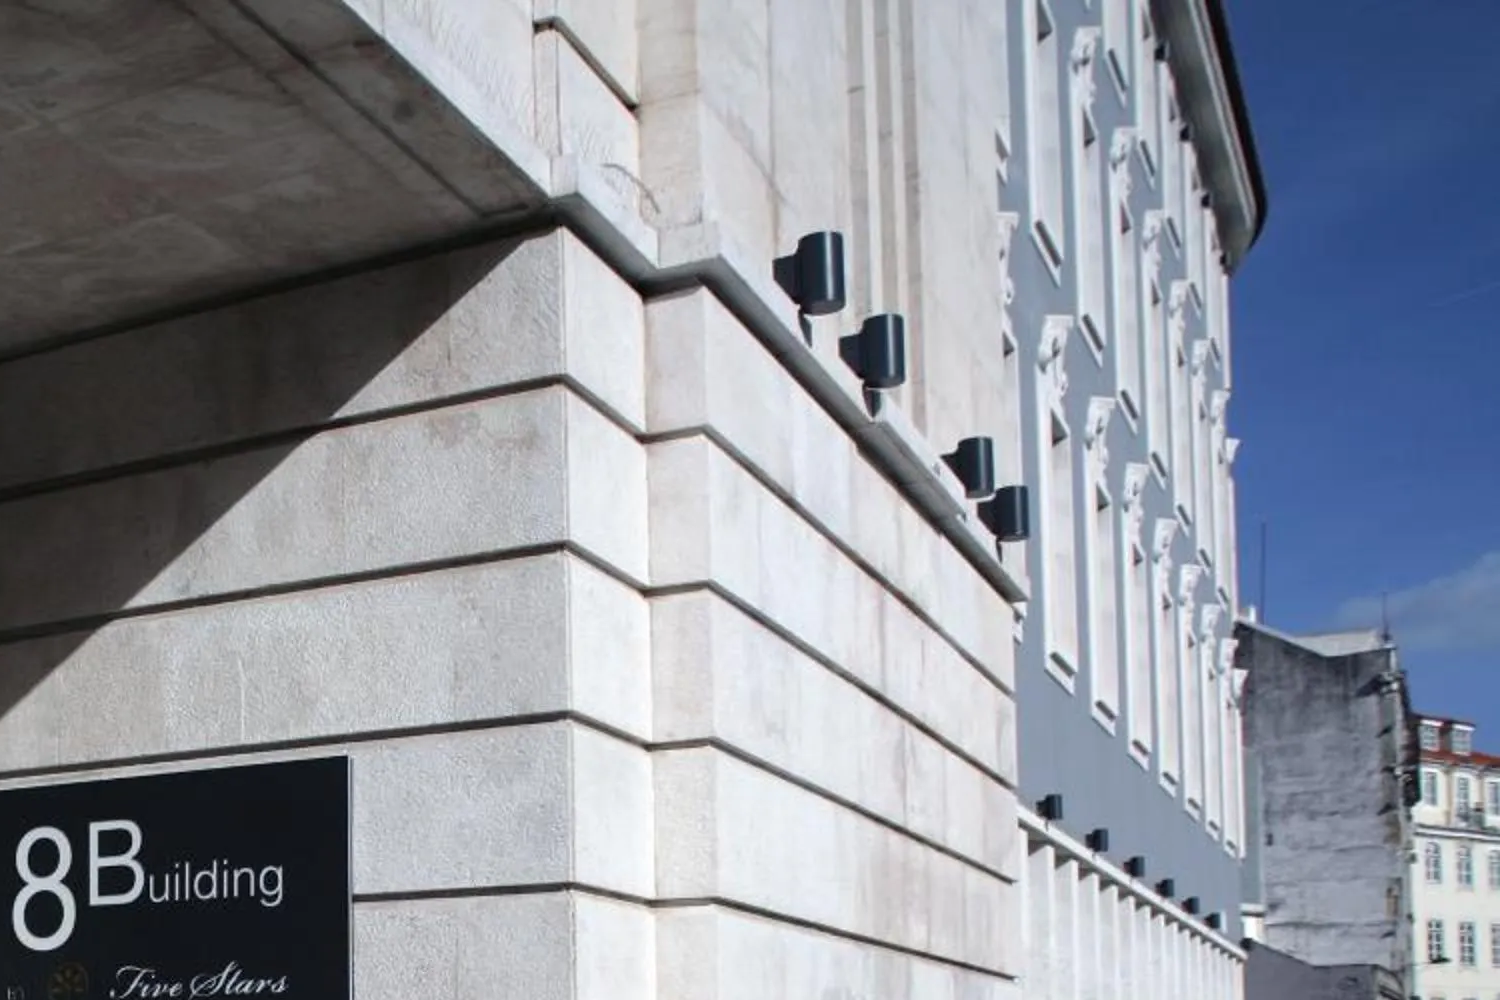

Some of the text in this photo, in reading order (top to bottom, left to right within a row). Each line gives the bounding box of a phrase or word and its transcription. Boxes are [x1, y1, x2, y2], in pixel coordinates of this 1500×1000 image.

[11, 818, 284, 952] 8 Building
[109, 960, 289, 1000] Five Stars
